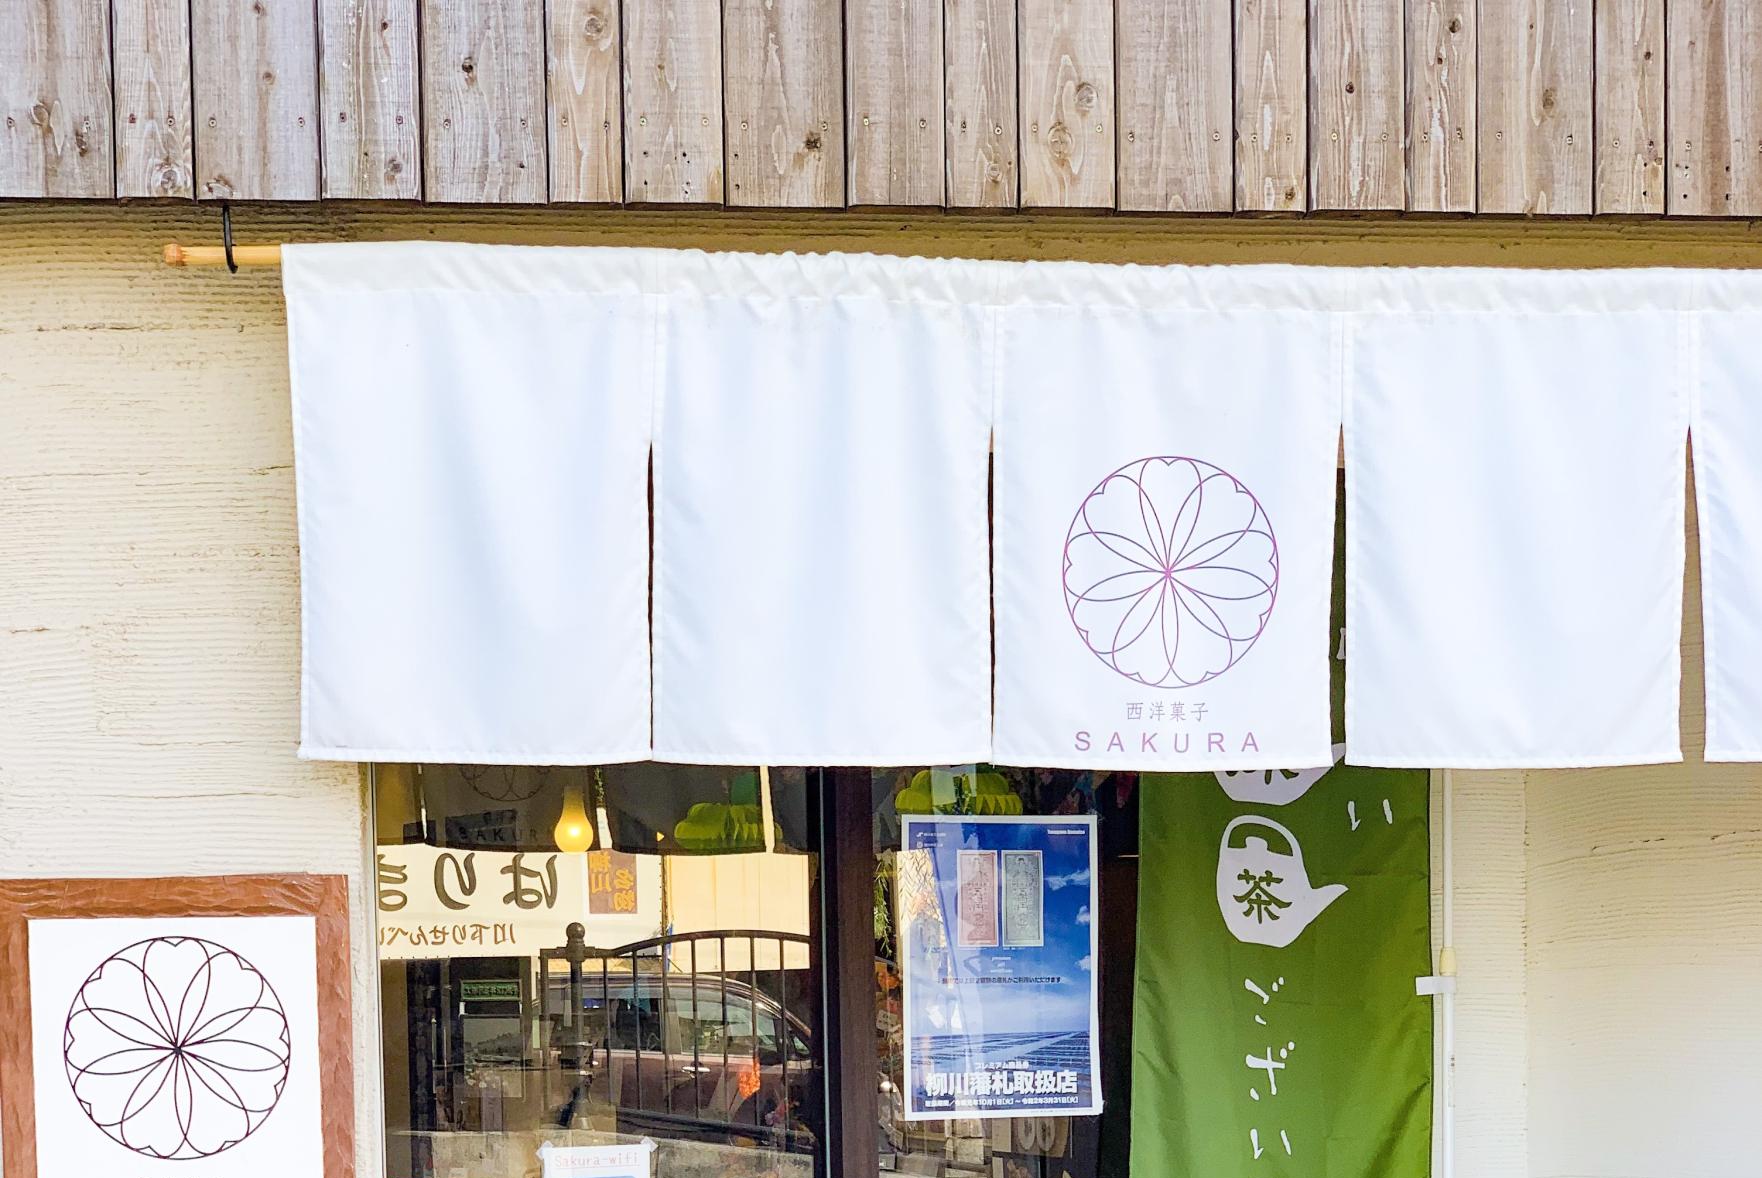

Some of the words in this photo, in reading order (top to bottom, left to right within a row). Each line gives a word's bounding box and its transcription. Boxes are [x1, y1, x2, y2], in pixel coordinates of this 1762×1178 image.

[1126, 701, 1209, 722] 西洋菓子
[1074, 730, 1260, 753] SAKURA
[925, 1069, 1079, 1097] 柳川藩札取扱店
[555, 1151, 638, 1168] Sakura-wifi
